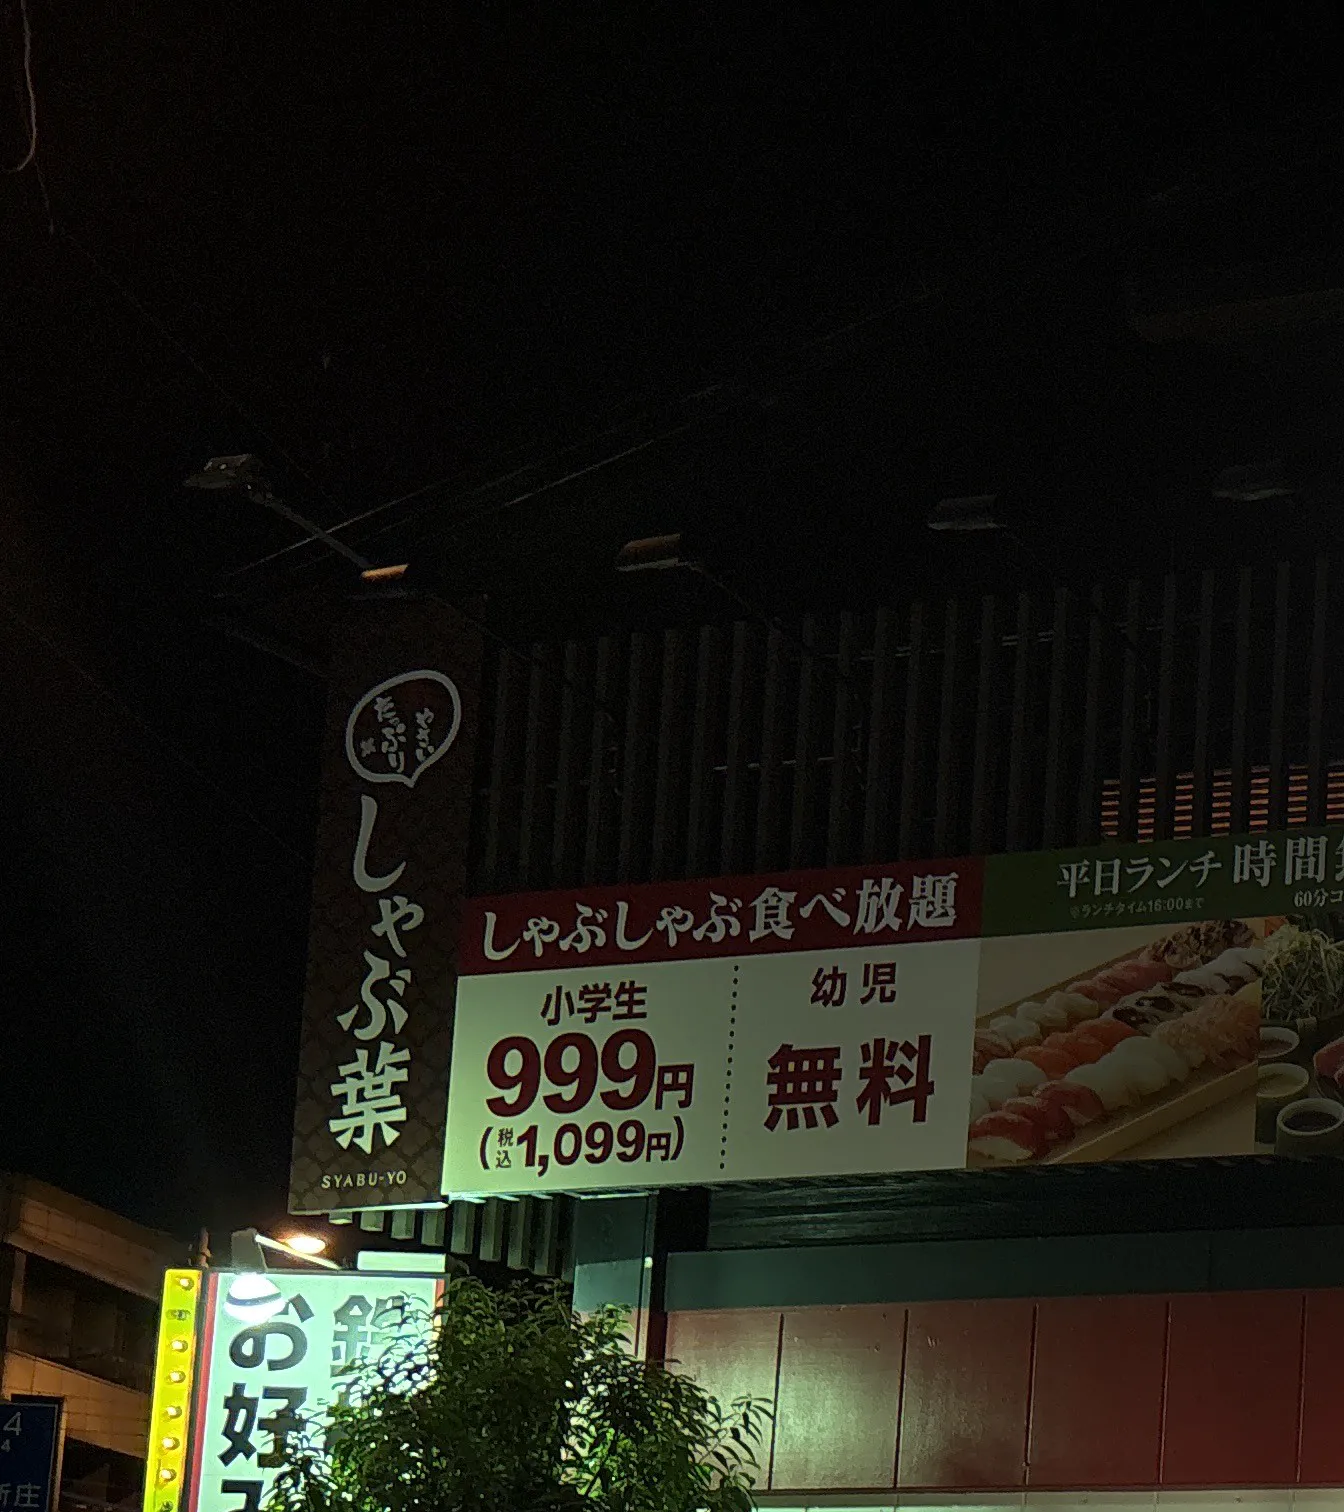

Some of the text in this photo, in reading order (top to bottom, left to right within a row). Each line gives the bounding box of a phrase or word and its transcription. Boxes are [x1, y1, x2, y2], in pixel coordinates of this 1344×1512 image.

[1057, 850, 1222, 898] 平日ランチ
[482, 871, 960, 961] しゃぶしゃぶ食べ放題
[329, 796, 424, 1154] しゃぶ葉
[541, 980, 648, 1026] 小学生
[811, 962, 898, 1008] 幼児
[487, 1029, 695, 1117] 999円
[763, 1033, 935, 1132] 無料
[321, 1170, 407, 1189] SYABU-YO
